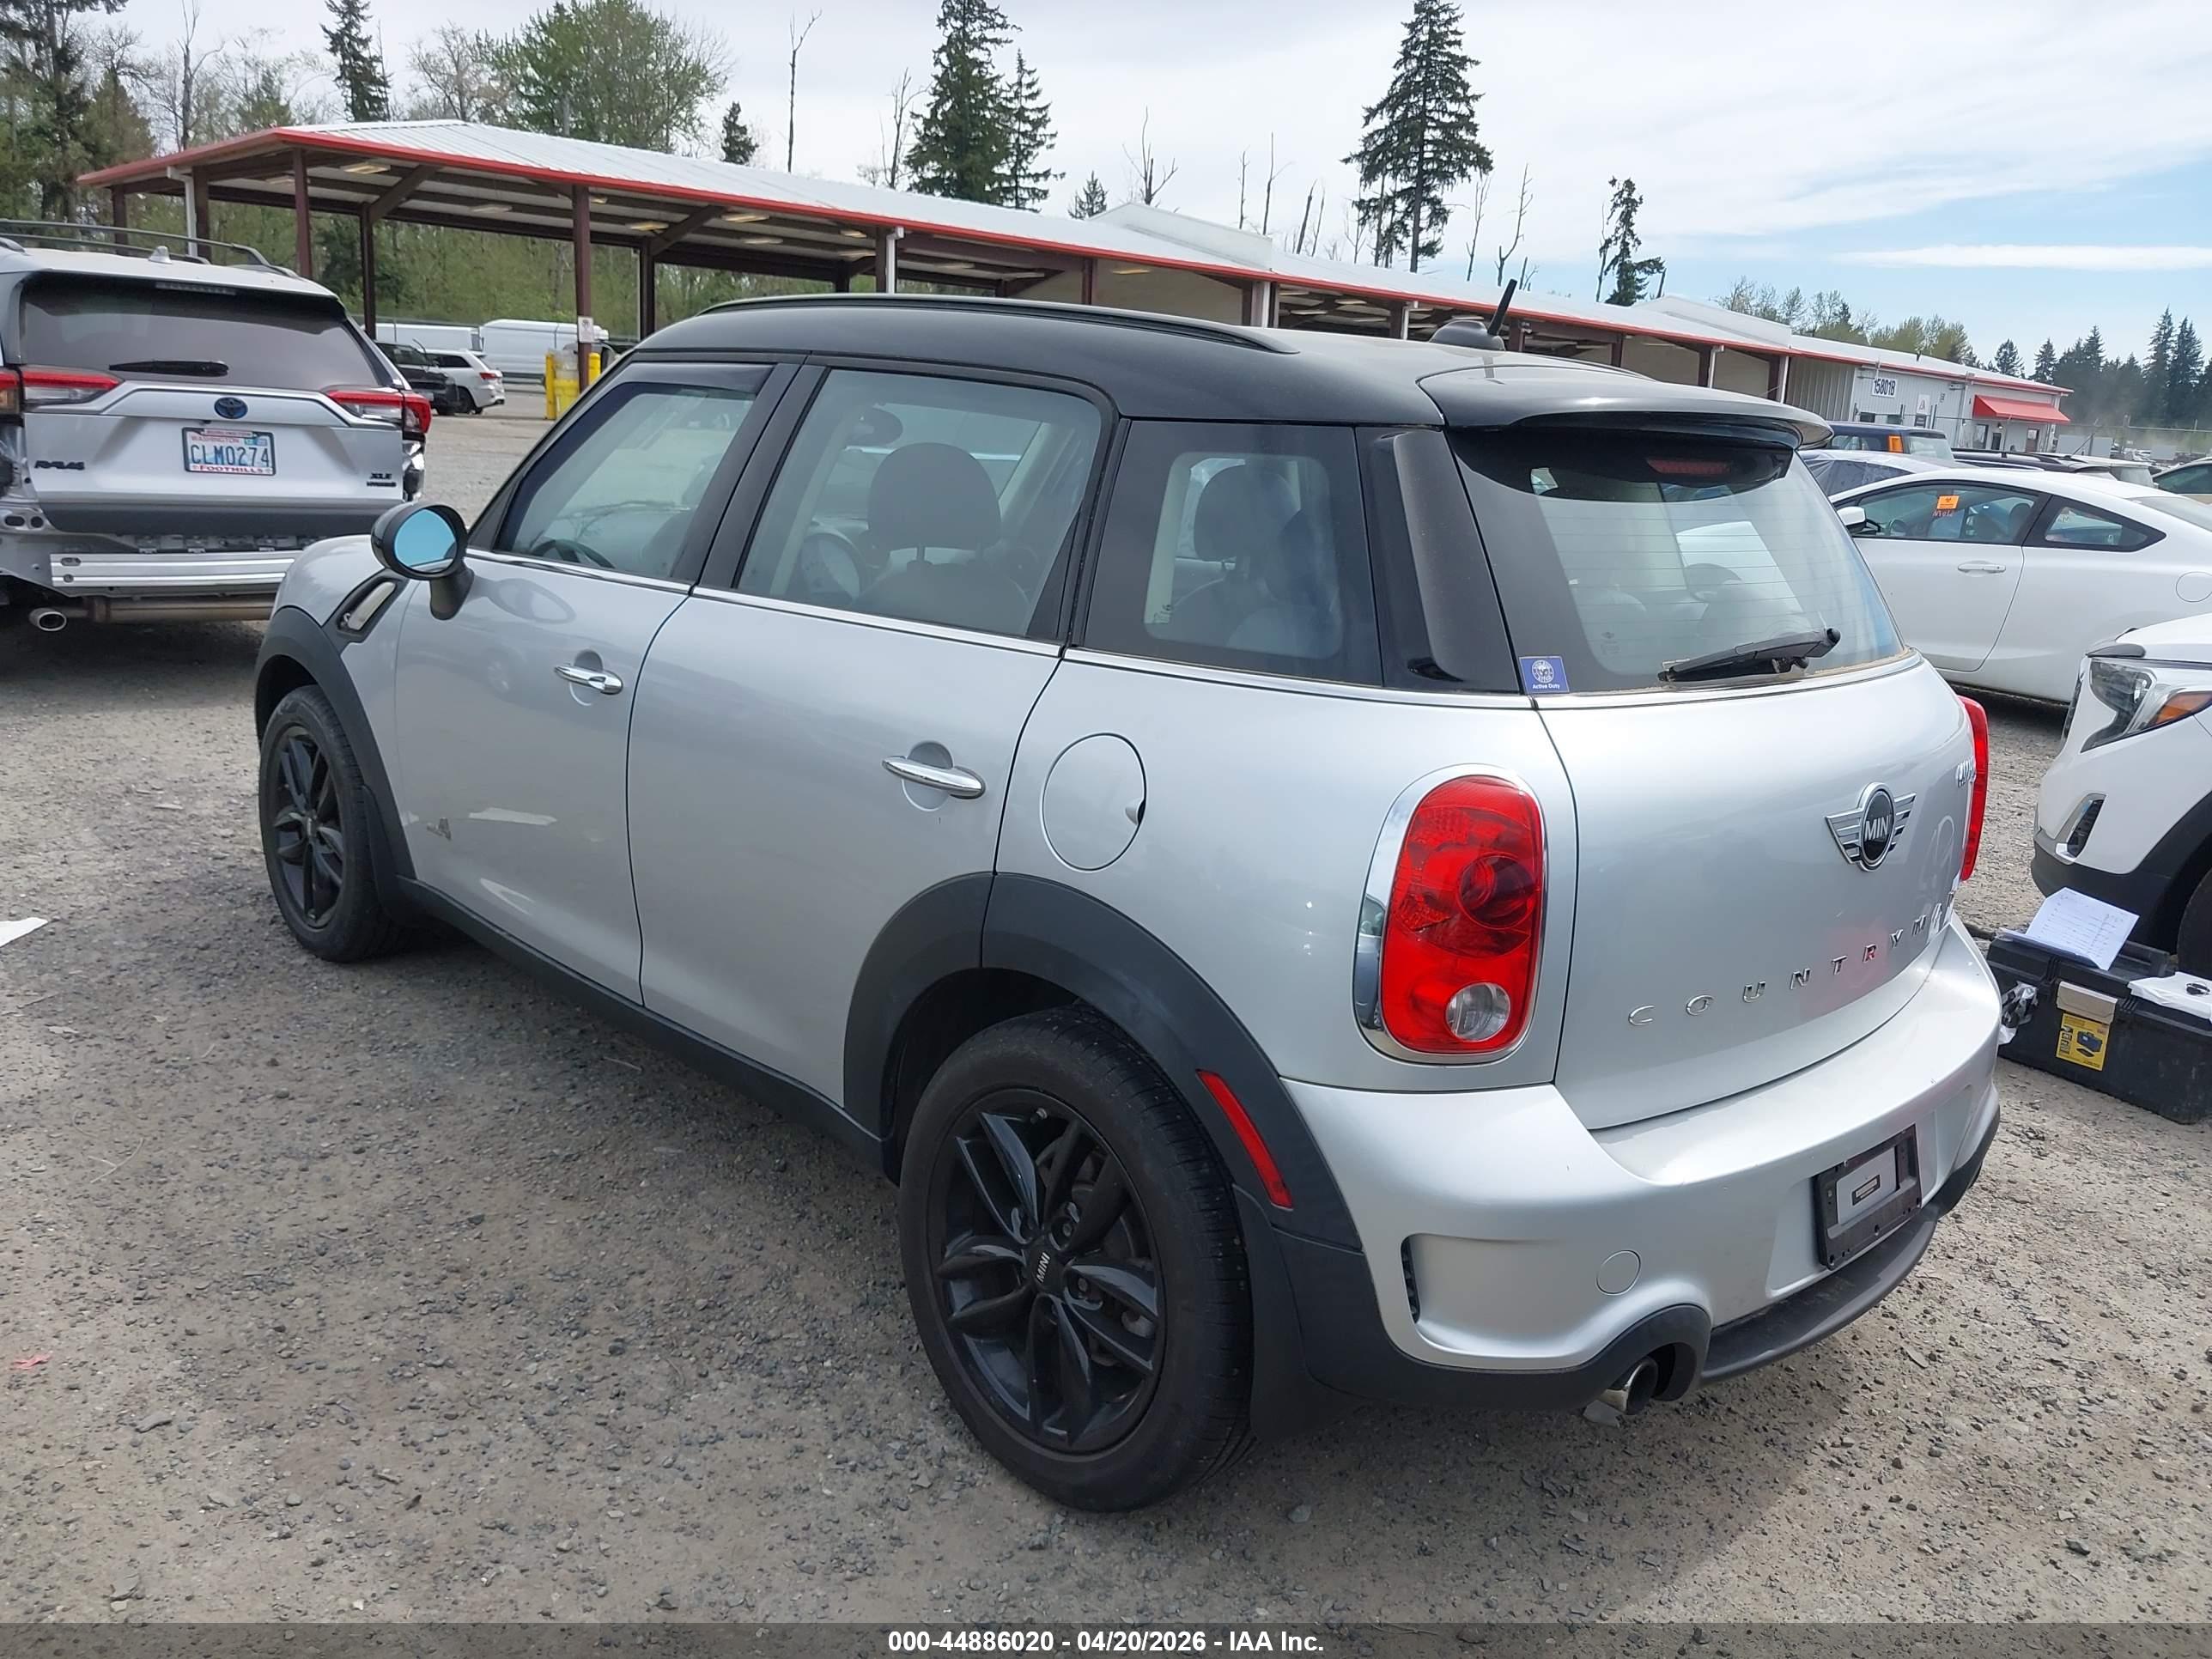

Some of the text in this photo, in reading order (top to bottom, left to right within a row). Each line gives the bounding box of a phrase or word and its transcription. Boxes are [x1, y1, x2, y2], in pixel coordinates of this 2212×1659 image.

[1874, 378, 1896, 396] 15801B
[191, 444, 270, 468] CLM0274
[1036, 1252, 1050, 1283] MINI
